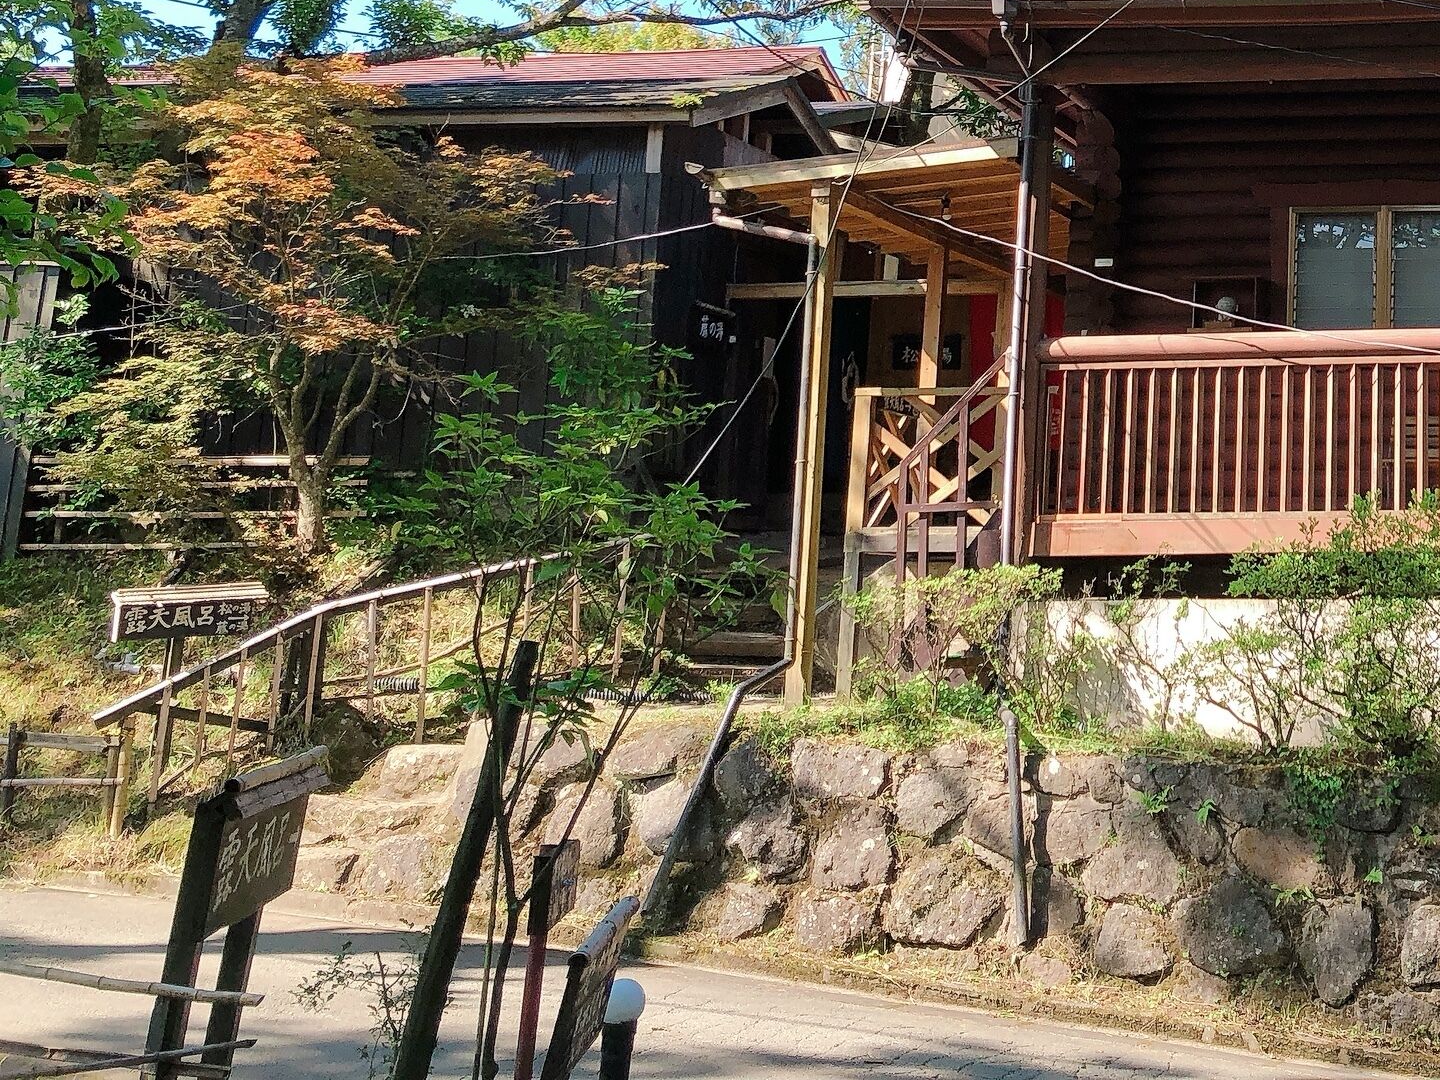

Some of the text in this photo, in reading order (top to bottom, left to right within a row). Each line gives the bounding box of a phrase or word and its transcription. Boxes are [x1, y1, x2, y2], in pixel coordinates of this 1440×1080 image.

[124, 605, 215, 635] 露天風呂
[212, 811, 291, 913] 露天風呂
